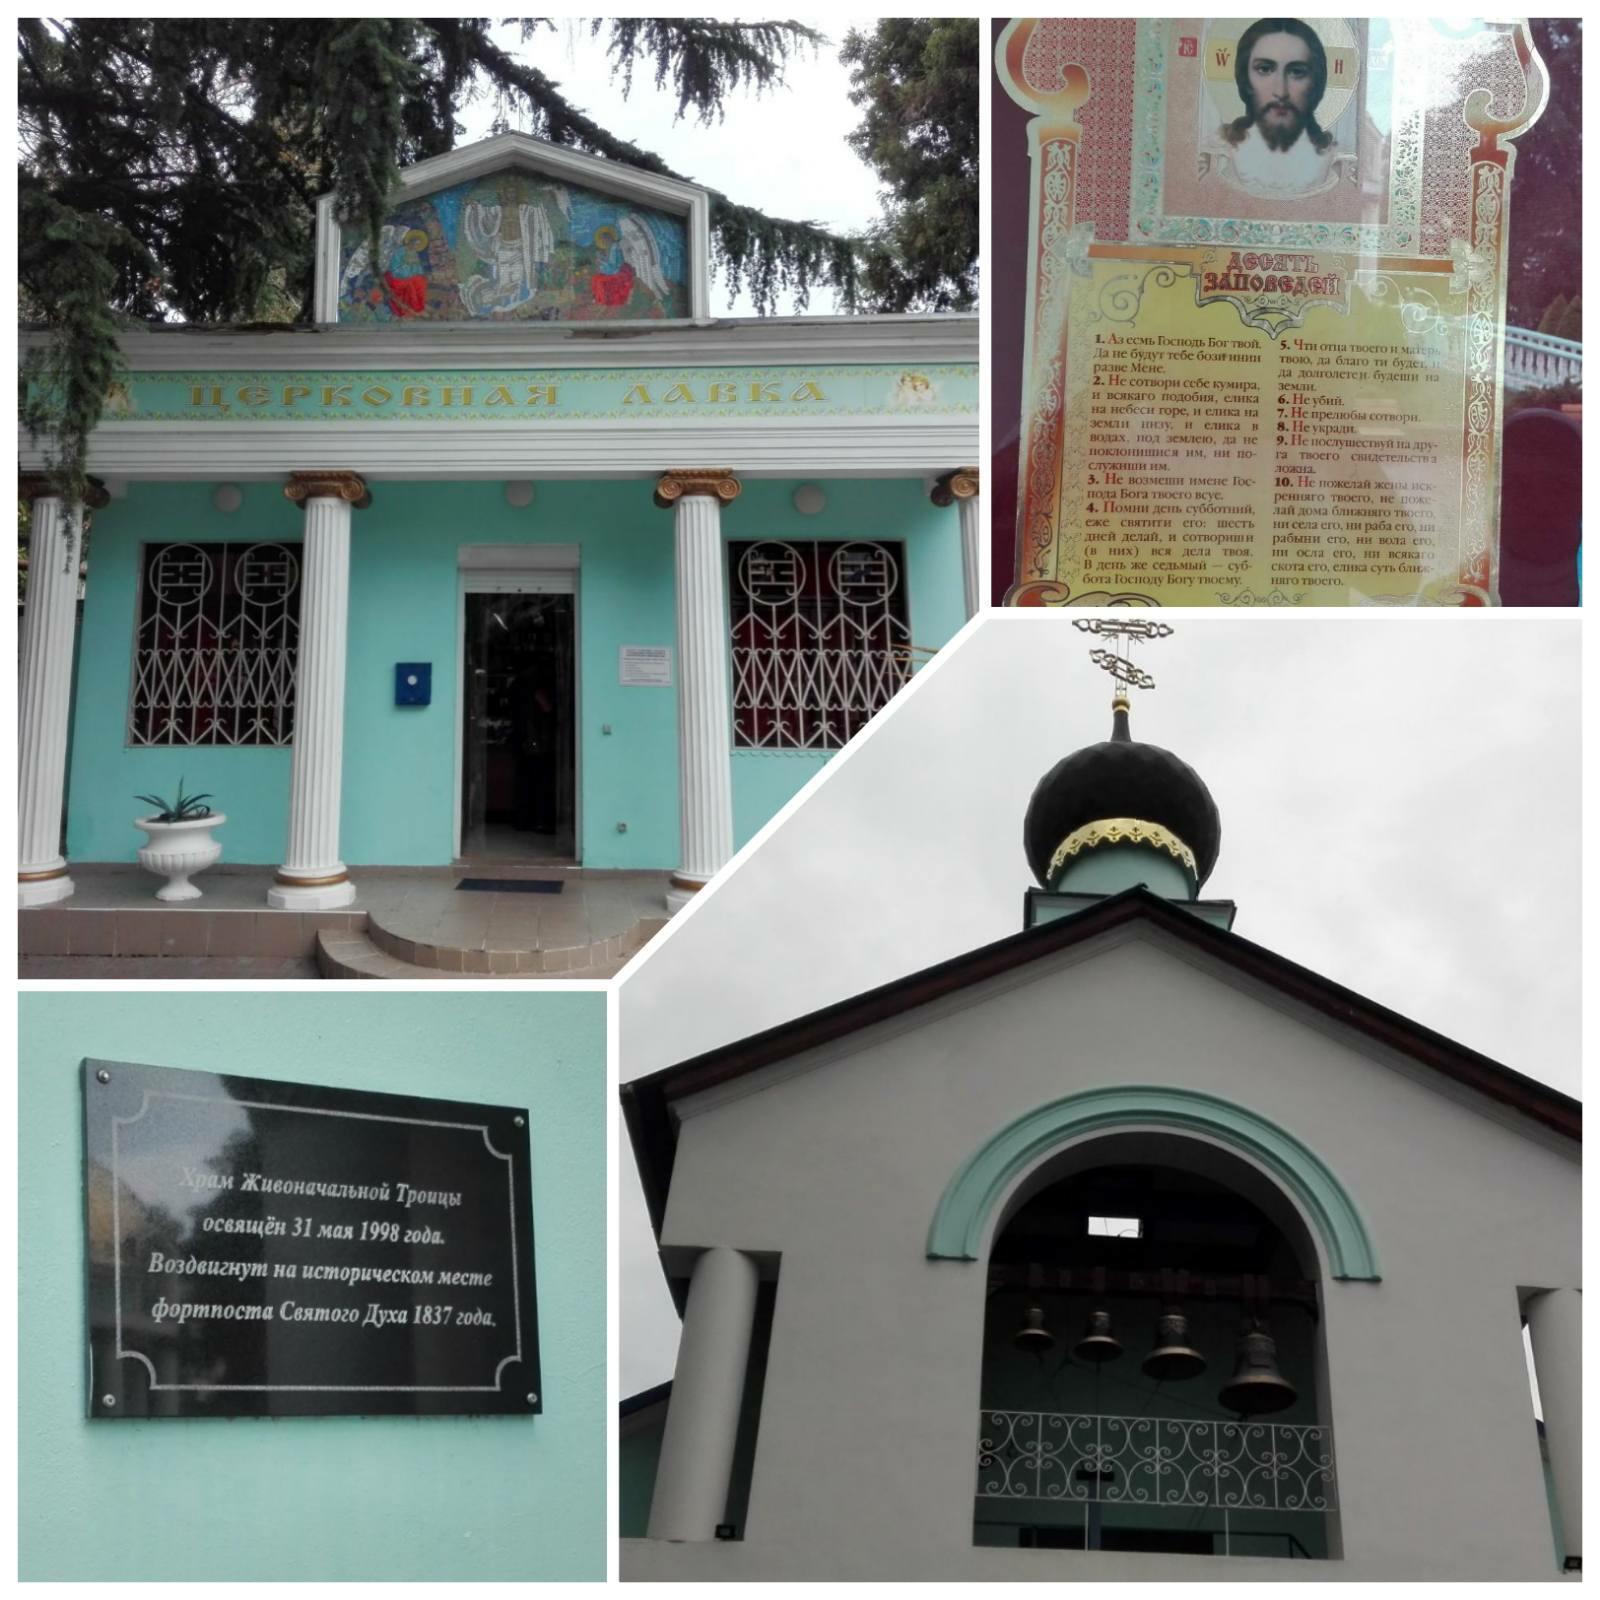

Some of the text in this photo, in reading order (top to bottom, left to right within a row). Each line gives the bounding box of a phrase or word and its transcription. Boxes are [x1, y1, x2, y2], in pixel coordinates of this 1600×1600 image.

[1226, 252, 1319, 274] ДЕСЯТЬ
[1203, 272, 1340, 297] ЗАПОВЕДЕЙ
[1095, 335, 1105, 344] 1.
[1108, 333, 1124, 345] Аз
[1127, 337, 1155, 345] есмь
[1158, 336, 1206, 349] Господь
[1208, 338, 1228, 347] Бог
[1280, 339, 1387, 353] 5. Чти отца твоего
[1094, 349, 1109, 359] Да
[1112, 350, 1126, 359] не
[1130, 347, 1163, 361] будут
[1168, 350, 1194, 360] тебе
[1316, 357, 1331, 366] да
[1336, 356, 1369, 366] благо
[1093, 364, 1128, 374] разве
[1092, 376, 1105, 385] 2.
[1108, 375, 1127, 386] Не
[1130, 378, 1180, 389] сотвори
[1183, 378, 1210, 388] себе
[1278, 369, 1419, 383] да будеши
[187, 379, 828, 413] ЦЕРКОВНАЯ ЛАВКА
[1107, 393, 1155, 401] всякаго
[1278, 395, 1289, 404] 6.
[1293, 394, 1311, 405] Не
[1092, 406, 1106, 414] на
[1111, 404, 1155, 415] небеси
[1206, 408, 1240, 416] елика
[1244, 409, 1258, 417] на
[1277, 409, 1288, 418] 7.
[1291, 407, 1309, 418] Не
[1311, 410, 1366, 422] прелюбы
[1090, 420, 1240, 430] земли елика
[1277, 422, 1289, 432] 8.
[1292, 421, 1310, 432] Не
[1137, 435, 1160, 443] под
[1223, 436, 1237, 445] да
[1243, 437, 1258, 445] не
[1277, 436, 1288, 446] 9.
[1291, 435, 1309, 446] Не
[1311, 438, 1394, 450] послушествуй
[1089, 448, 1178, 457] поклонишися
[1300, 452, 1340, 460] твоего
[1088, 474, 1099, 485] 3.
[1105, 473, 1123, 484] Не
[1189, 478, 1228, 486] имене
[1232, 477, 1256, 486] Гос-
[1275, 477, 1371, 488] 10. Не пожелай
[1087, 491, 1117, 500] пода
[1120, 489, 1148, 499] Бога
[1274, 493, 1325, 504] ренняго
[1380, 495, 1394, 503] не
[1086, 502, 1098, 512] 4.
[1104, 501, 1149, 513] Помни
[1152, 505, 1182, 515] день
[1273, 506, 1391, 517] лай дома ближняго
[1086, 519, 1254, 529] еже святити его: шесть
[1273, 521, 1289, 529] ни
[1292, 521, 1318, 529] села
[1365, 521, 1392, 533] раба
[1084, 532, 1116, 542] дней
[1182, 534, 1254, 544] сотвориши
[1272, 534, 1320, 545] рабыни
[1357, 536, 1372, 544] ни
[1084, 547, 1097, 557] (в
[1109, 547, 1139, 557] них)
[1152, 548, 1171, 556] вся
[1182, 548, 1211, 557] дела
[1272, 549, 1288, 557] ни
[1296, 550, 1324, 558] осла
[1084, 560, 1252, 573] В день же седьмый суб-
[1271, 563, 1305, 571] скота
[1333, 564, 1367, 572] елика
[1371, 564, 1396, 575] суть
[1083, 574, 1111, 583] бота
[1115, 575, 1165, 586] Господу
[1167, 575, 1195, 586] Богу
[1271, 577, 1299, 585] няго
[177, 1164, 462, 1209] Храм Живоначальной Троицы
[202, 1214, 447, 1246] освящён 31 мая 1998 года.
[148, 1252, 493, 1288] Воздвигнут на историческом месте
[151, 1296, 497, 1329] фортпоста Святого Духа 1837 года.
